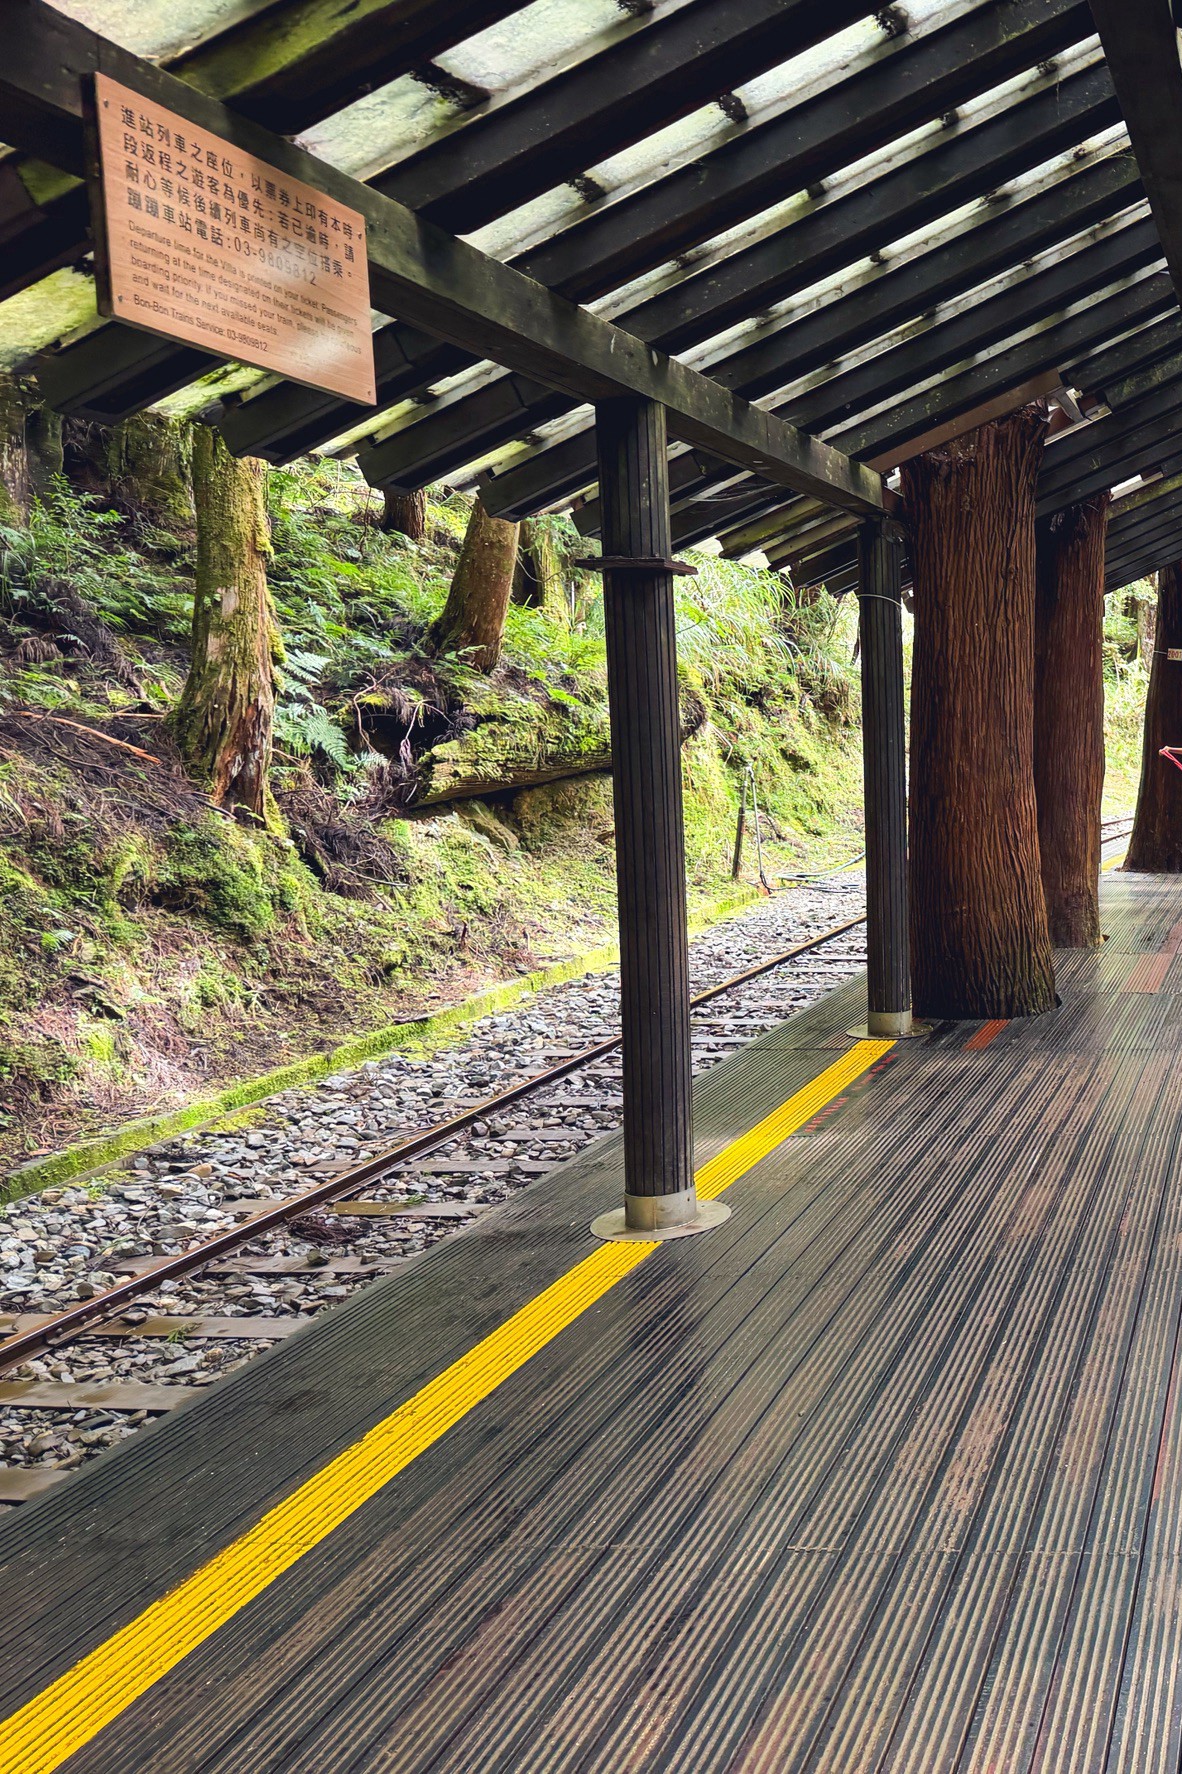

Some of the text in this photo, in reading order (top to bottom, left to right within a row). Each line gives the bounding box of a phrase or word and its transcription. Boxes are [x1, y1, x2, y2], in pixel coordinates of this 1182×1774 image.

[128, 219, 171, 250] Departure
[173, 238, 191, 255] time
[193, 247, 203, 261] for
[205, 252, 218, 267] the
[220, 258, 236, 275] Villa
[247, 270, 271, 292] printed
[284, 288, 299, 304] your
[321, 302, 357, 328] Passengers
[129, 237, 169, 265] returning
[182, 259, 195, 273] the
[198, 266, 215, 281] time
[218, 274, 259, 302] designated
[273, 297, 288, 311] their
[290, 304, 313, 321] tickets
[314, 314, 325, 326] will
[130, 253, 169, 281] boarding
[213, 289, 227, 304] you
[229, 293, 257, 313] missed
[259, 307, 274, 322] your
[132, 270, 148, 287] and
[151, 278, 169, 295] wait
[171, 286, 183, 300] for
[185, 291, 199, 306] the
[200, 297, 218, 313] next
[220, 305, 254, 327] available
[133, 293, 168, 316] Bon-Bon
[170, 307, 193, 325] Trains
